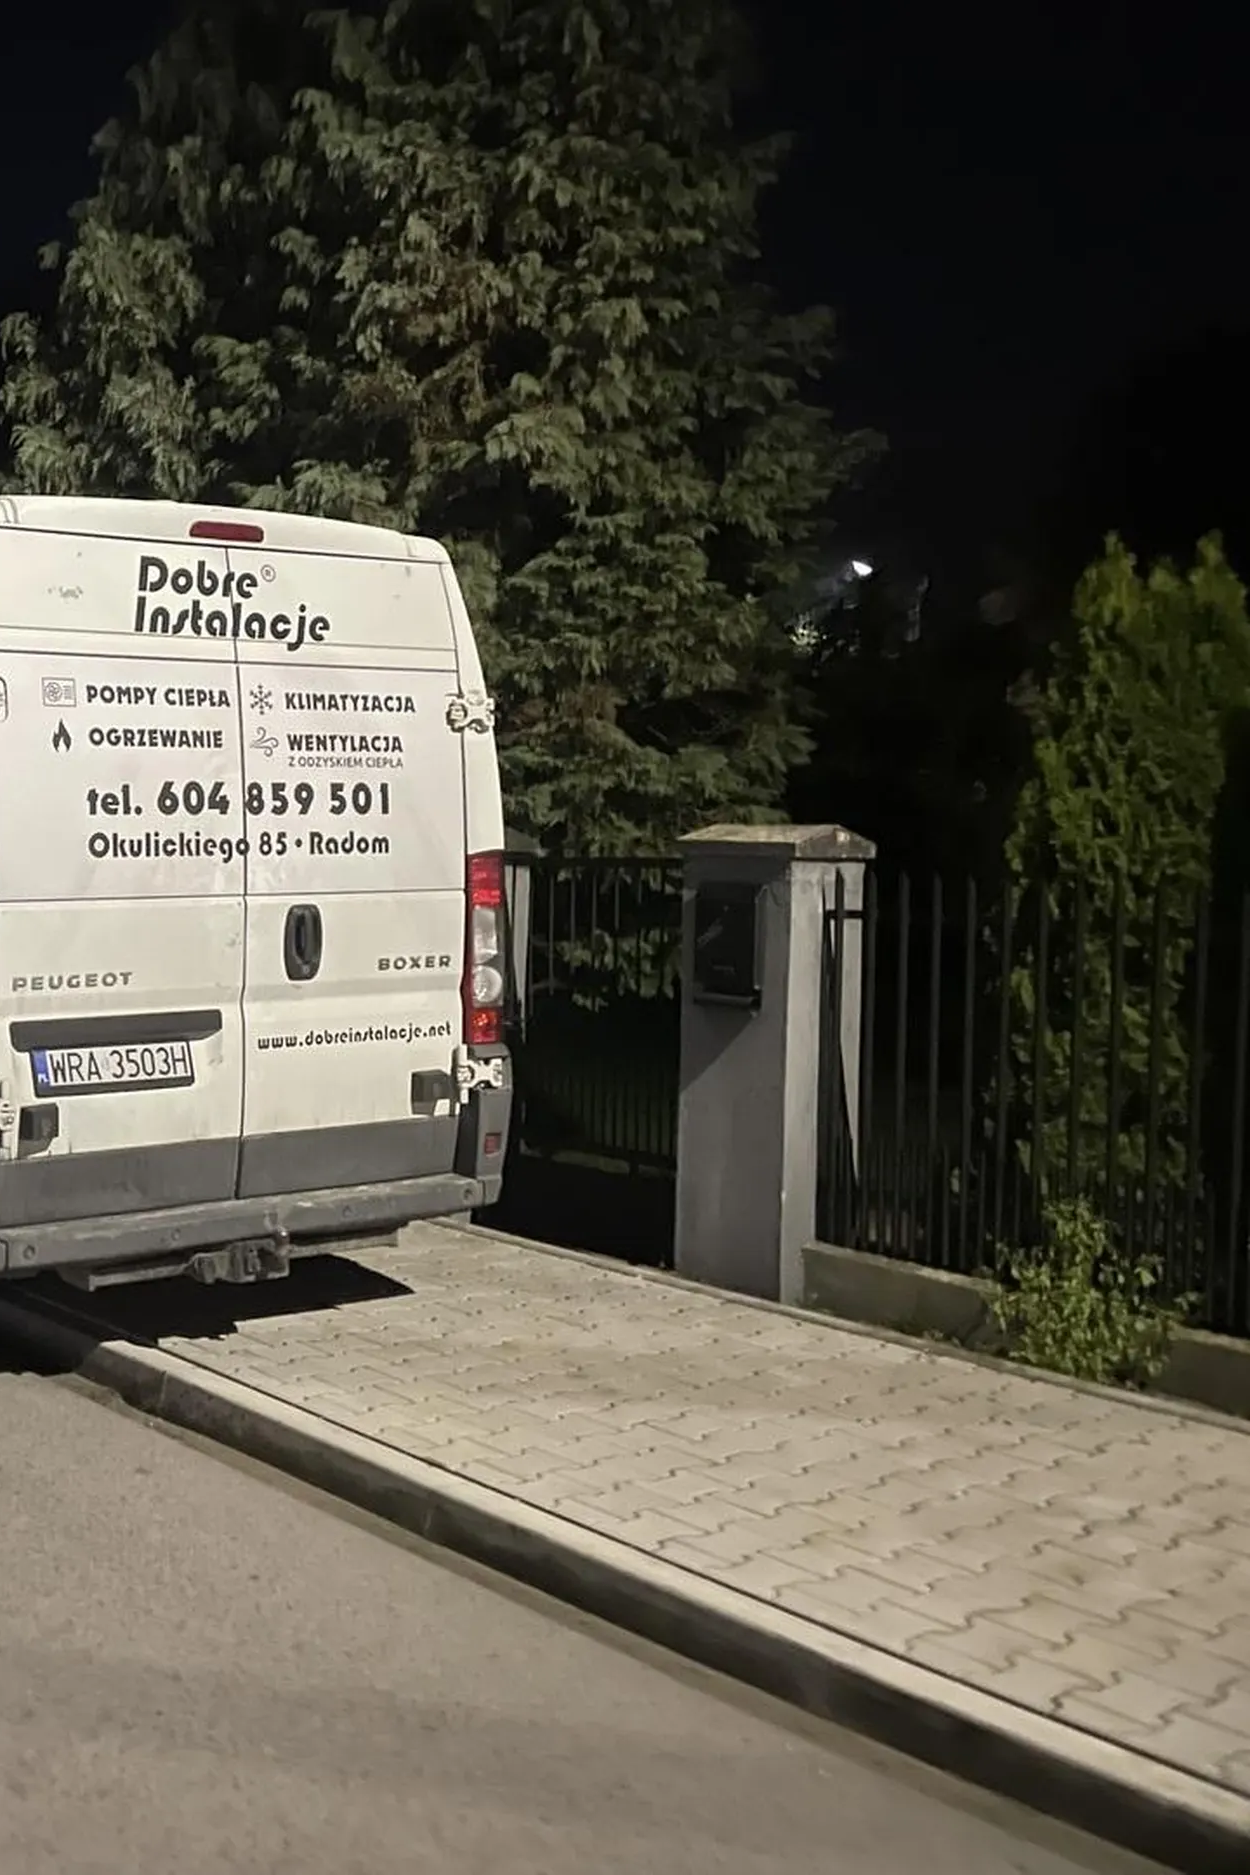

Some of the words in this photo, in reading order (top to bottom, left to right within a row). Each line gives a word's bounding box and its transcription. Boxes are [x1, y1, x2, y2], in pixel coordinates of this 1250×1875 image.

[138, 555, 258, 599] Dobre
[134, 595, 331, 652] Instalacje
[86, 684, 157, 705] POMPY
[163, 688, 231, 708] CIEPŁA
[284, 692, 416, 713] KLIMATYZACJA
[88, 727, 223, 749] OGRZEWANIE
[286, 733, 404, 753] WENTYLACJA
[288, 757, 295, 767] Z
[297, 756, 363, 768] ODZYSKIEM
[365, 757, 404, 769] CIEPŁA
[86, 784, 143, 815] tel.
[157, 781, 230, 815] 604
[245, 782, 315, 815] 859
[328, 782, 390, 815] 501
[88, 831, 250, 863] Okulickiego
[258, 831, 288, 856] 85
[309, 831, 390, 855] Radom
[377, 954, 452, 971] BOXER
[12, 971, 134, 992] PEUGEOT
[257, 1021, 452, 1050] www.dobreinstalacje.net
[49, 1052, 103, 1083] WRA
[108, 1044, 190, 1080] 3503H
